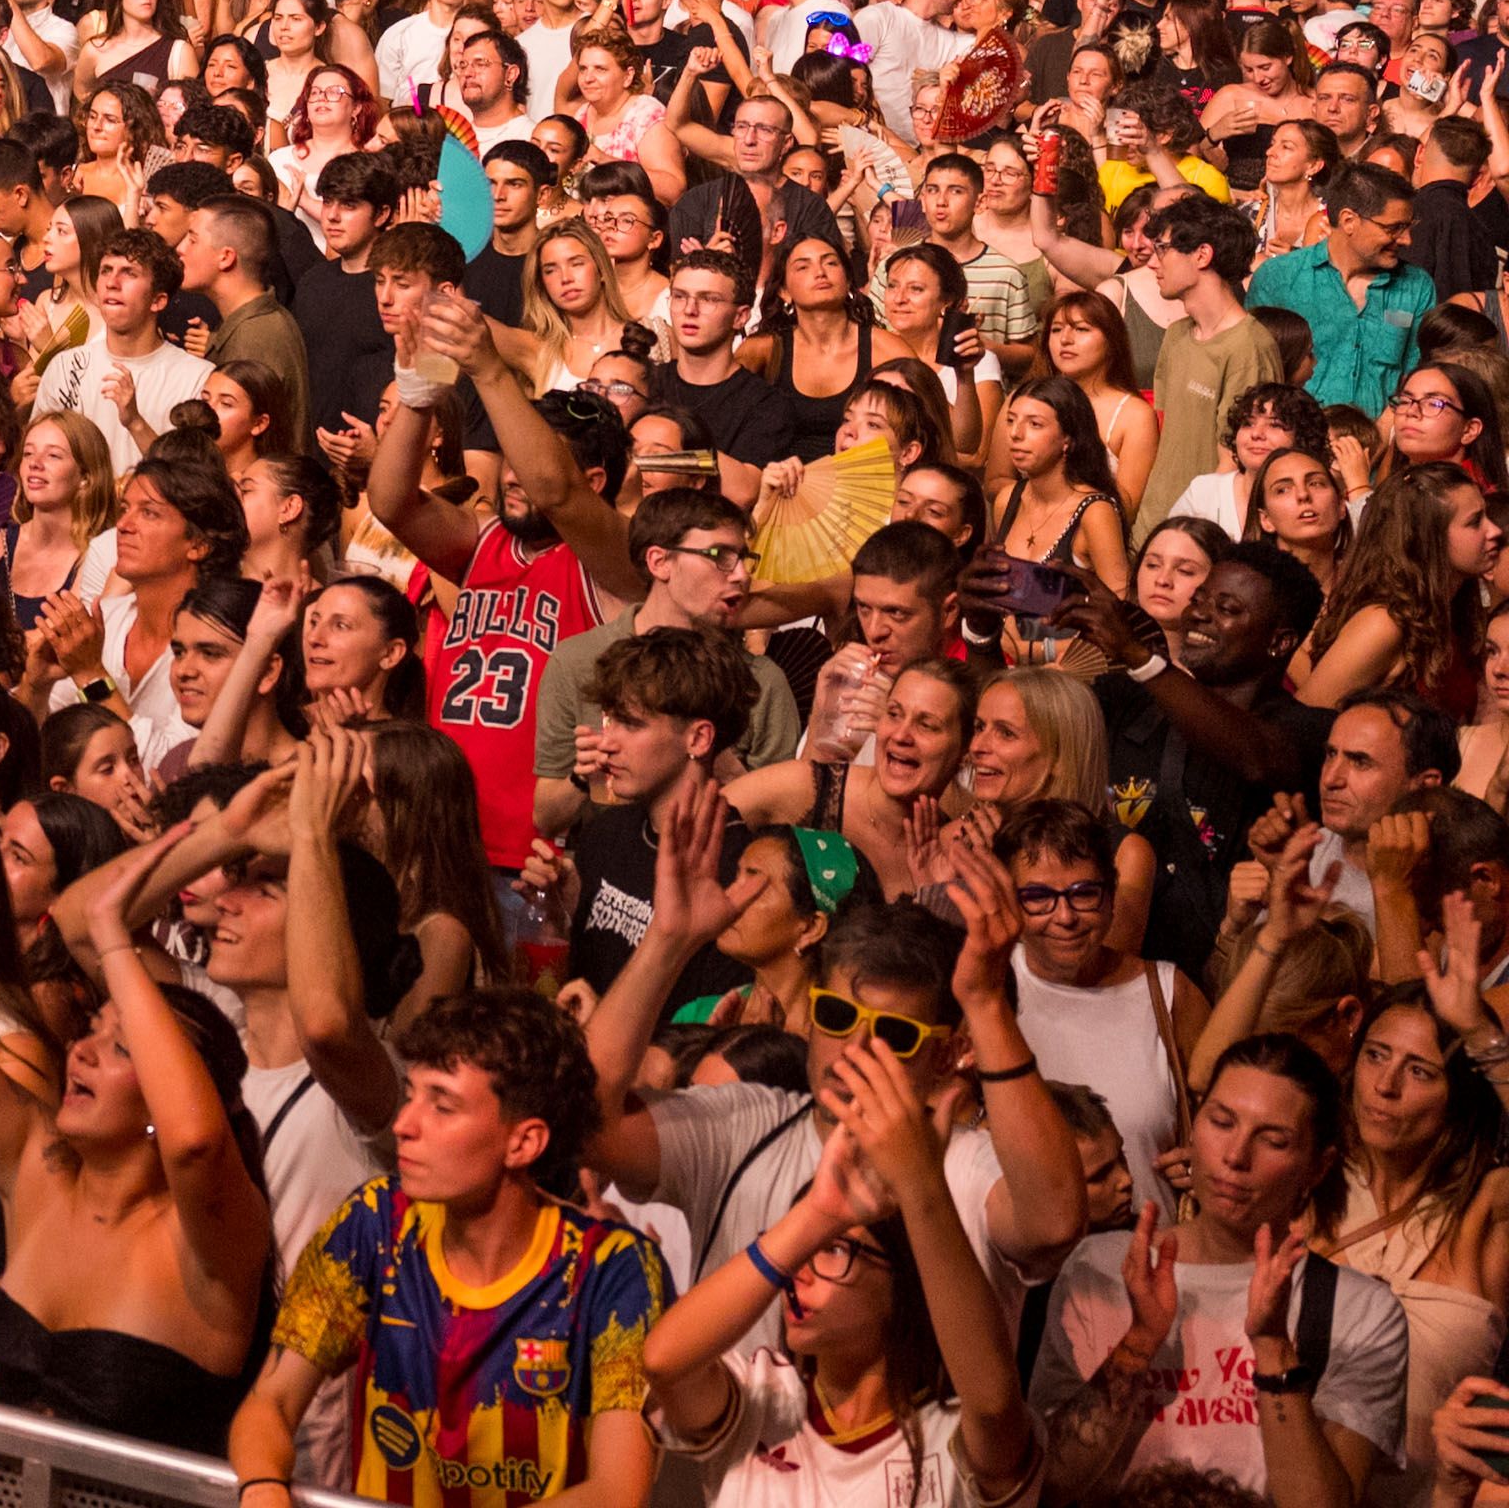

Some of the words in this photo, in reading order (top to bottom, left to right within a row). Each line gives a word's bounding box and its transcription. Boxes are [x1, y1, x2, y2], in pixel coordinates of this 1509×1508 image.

[443, 585, 561, 653] BULLS
[441, 647, 535, 730] 23
[436, 1457, 553, 1500] potify
